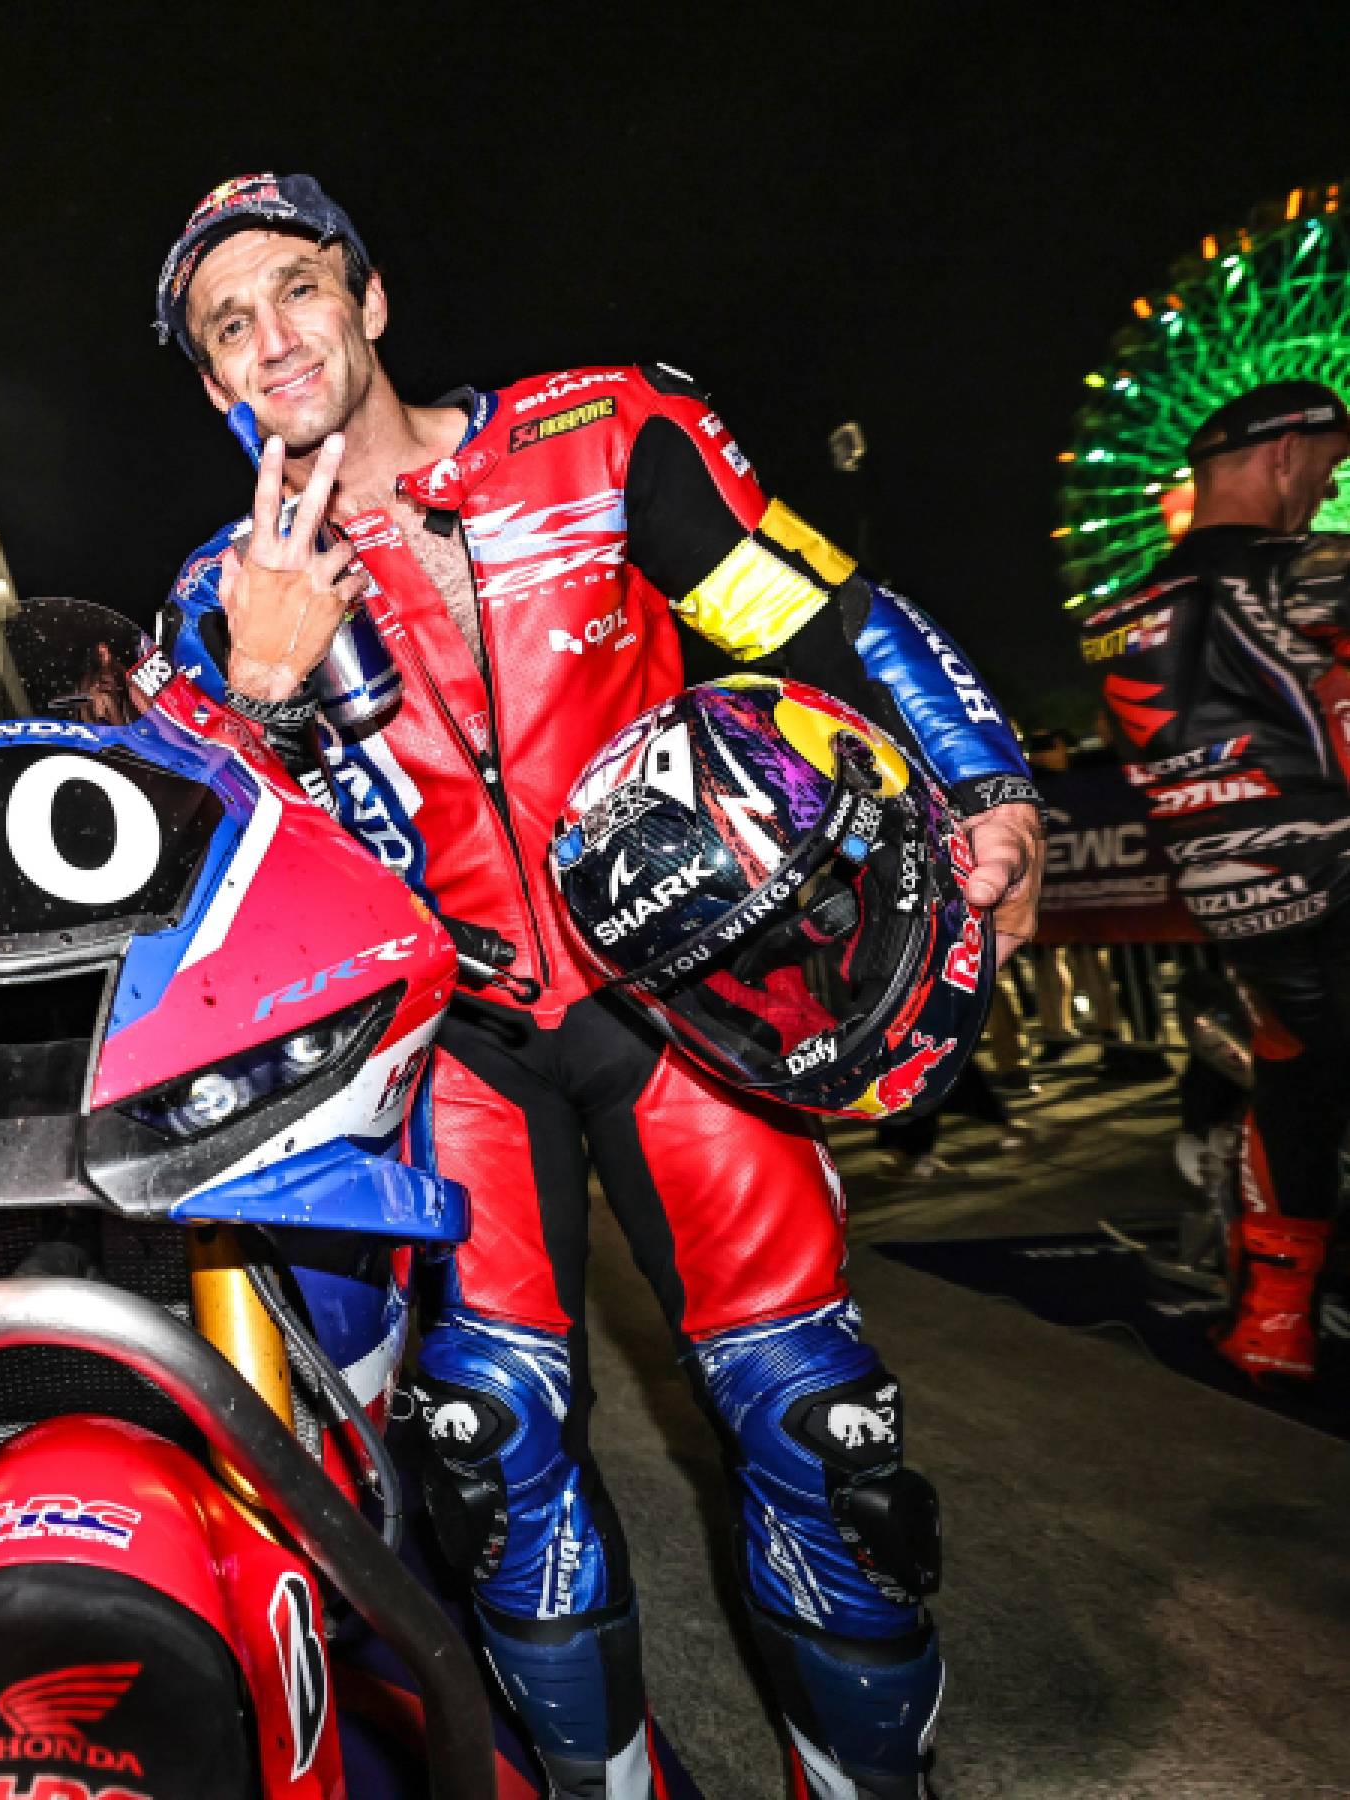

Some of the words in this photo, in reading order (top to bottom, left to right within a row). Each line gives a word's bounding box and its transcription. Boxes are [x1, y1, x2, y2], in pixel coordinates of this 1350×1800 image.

[595, 850, 717, 947] SHARK
[660, 944, 712, 978] YOU
[718, 868, 805, 943] WINGS
[785, 1036, 839, 1077] Dafy
